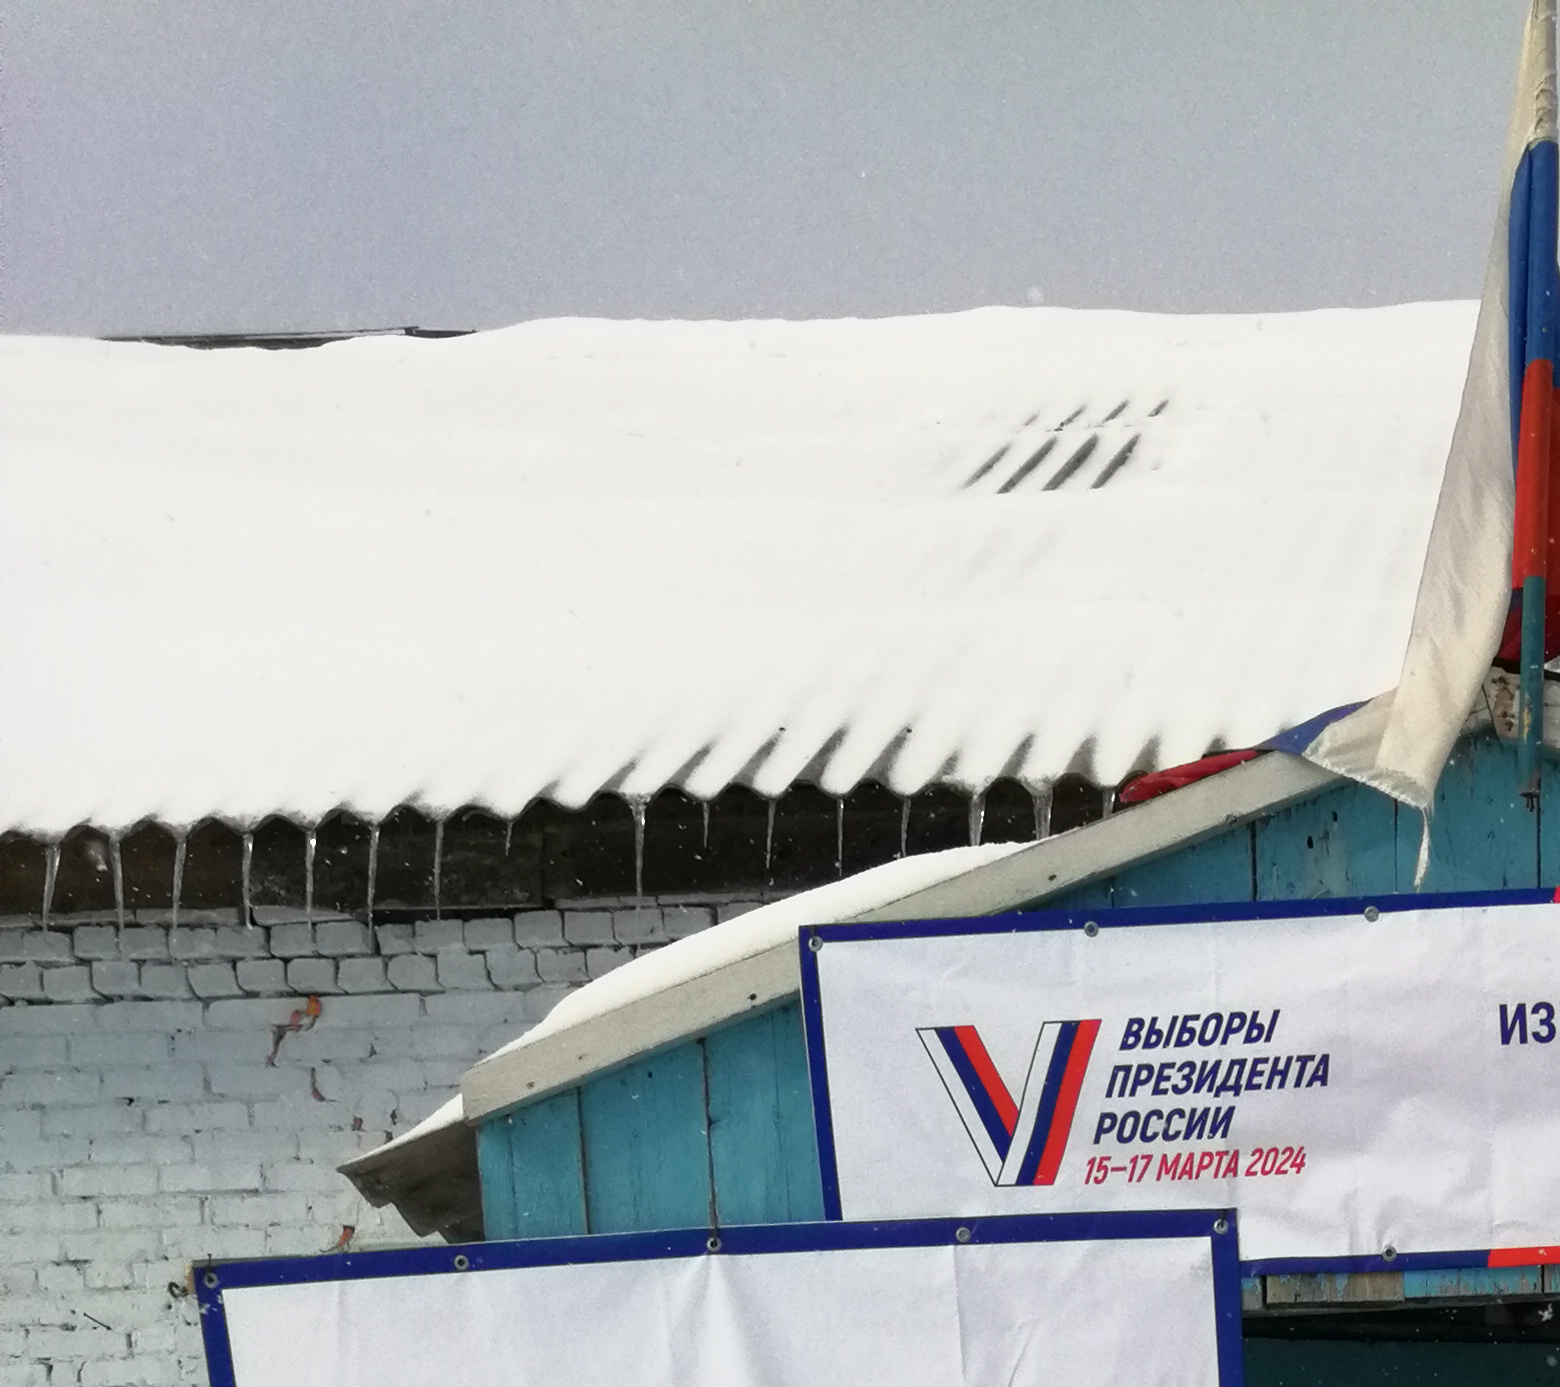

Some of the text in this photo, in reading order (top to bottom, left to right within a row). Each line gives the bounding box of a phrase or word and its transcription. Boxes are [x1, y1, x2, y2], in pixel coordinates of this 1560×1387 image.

[1119, 1009, 1280, 1051] ВЫБОРЫ
[1105, 1053, 1330, 1098] ПРЕЗИДЕНТА
[1093, 1106, 1235, 1145] РОССИИ
[1156, 1149, 1240, 1181] МАРТА
[1245, 1146, 1306, 1177] 2024
